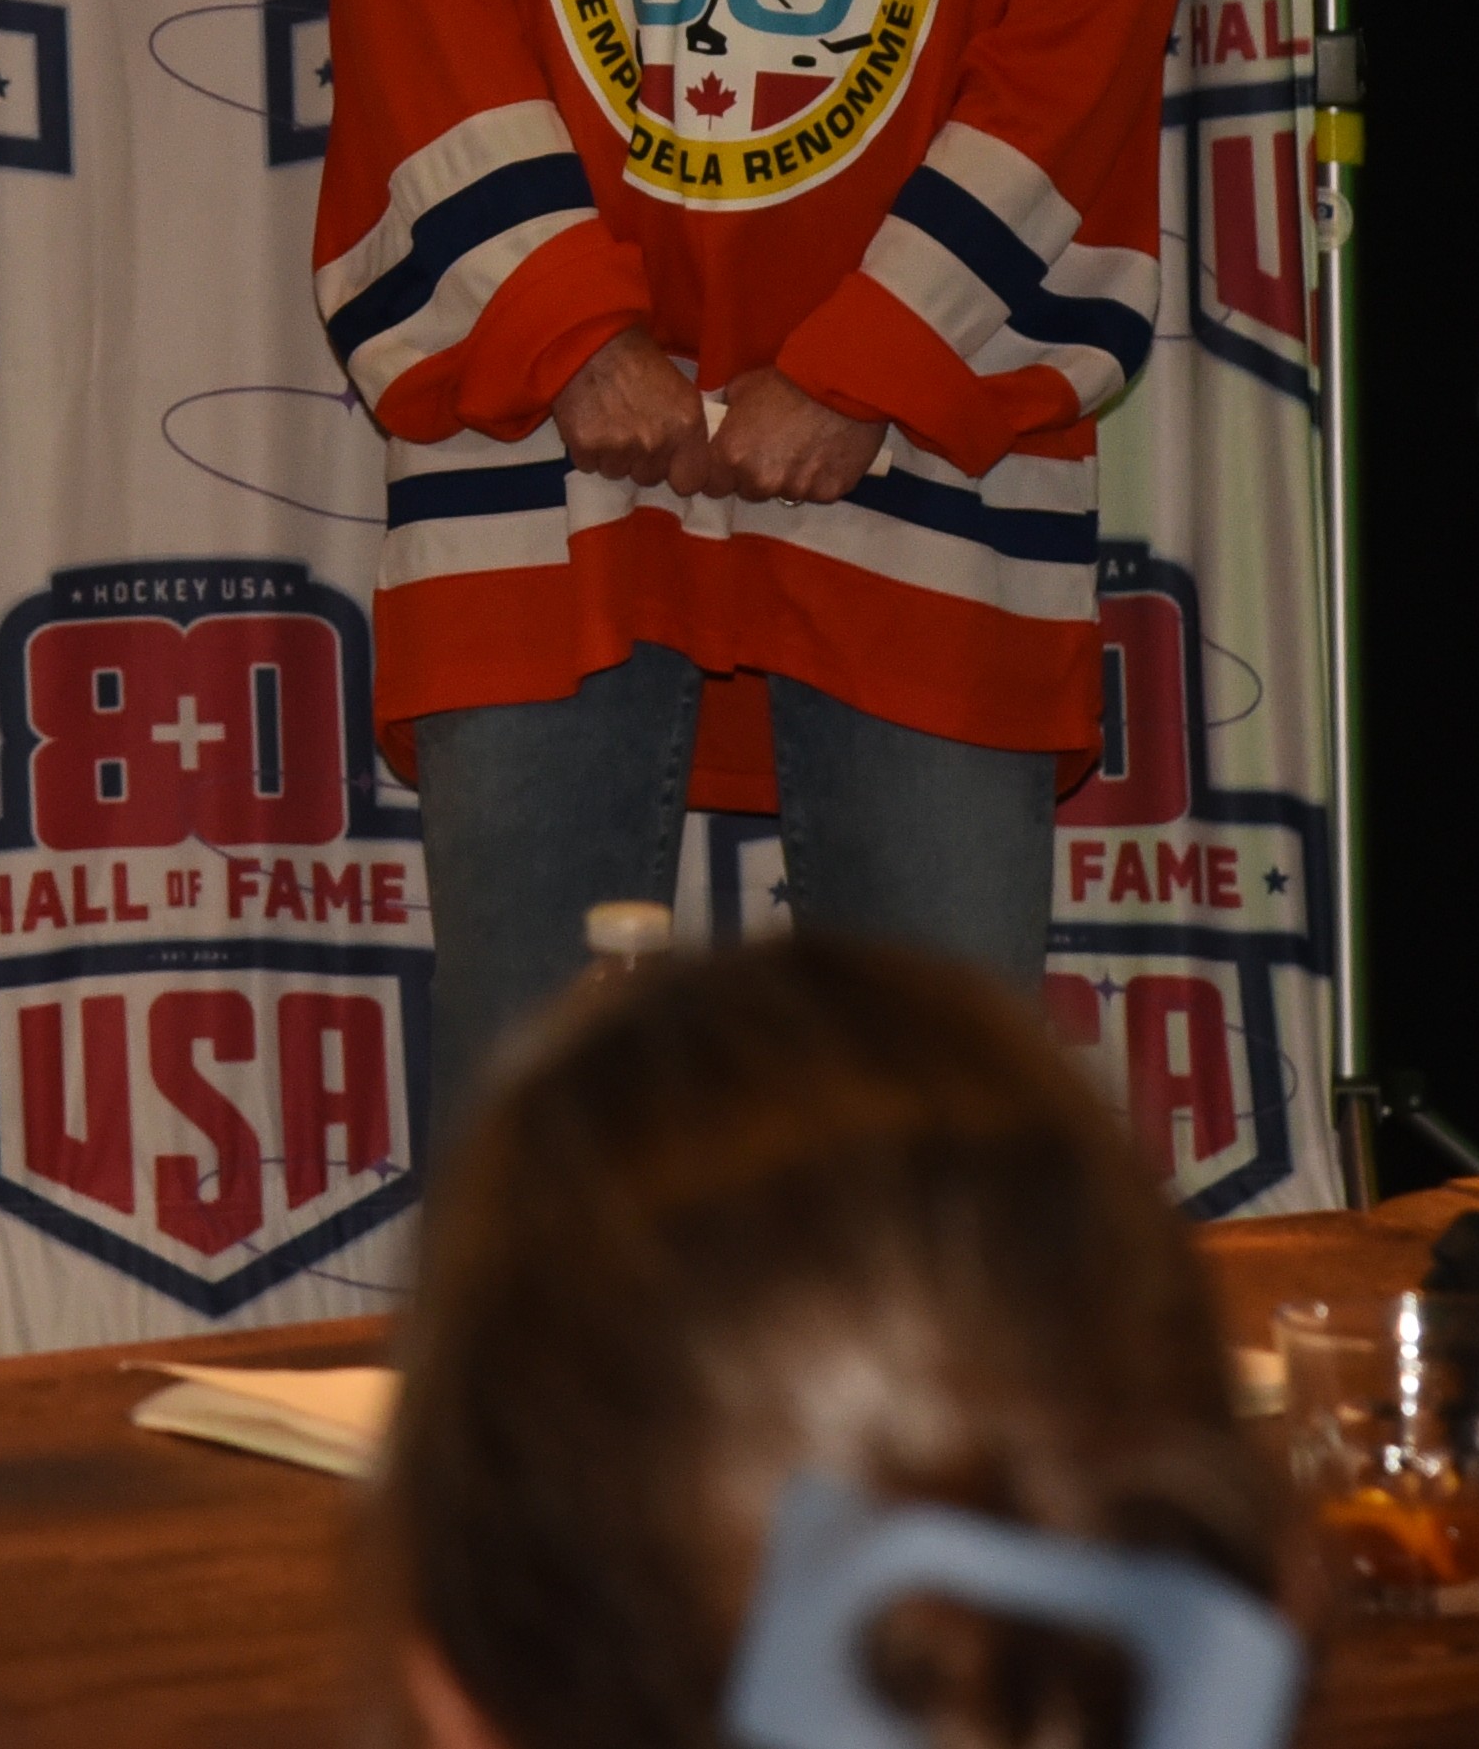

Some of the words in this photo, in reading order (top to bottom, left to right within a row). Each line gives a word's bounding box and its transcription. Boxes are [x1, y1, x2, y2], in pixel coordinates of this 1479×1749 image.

[94, 578, 207, 604] HOCKEY
[220, 576, 275, 601] USA
[167, 871, 200, 906] OF
[228, 858, 406, 923] FAME
[1071, 842, 1240, 907] FAME
[19, 990, 390, 1256] USA
